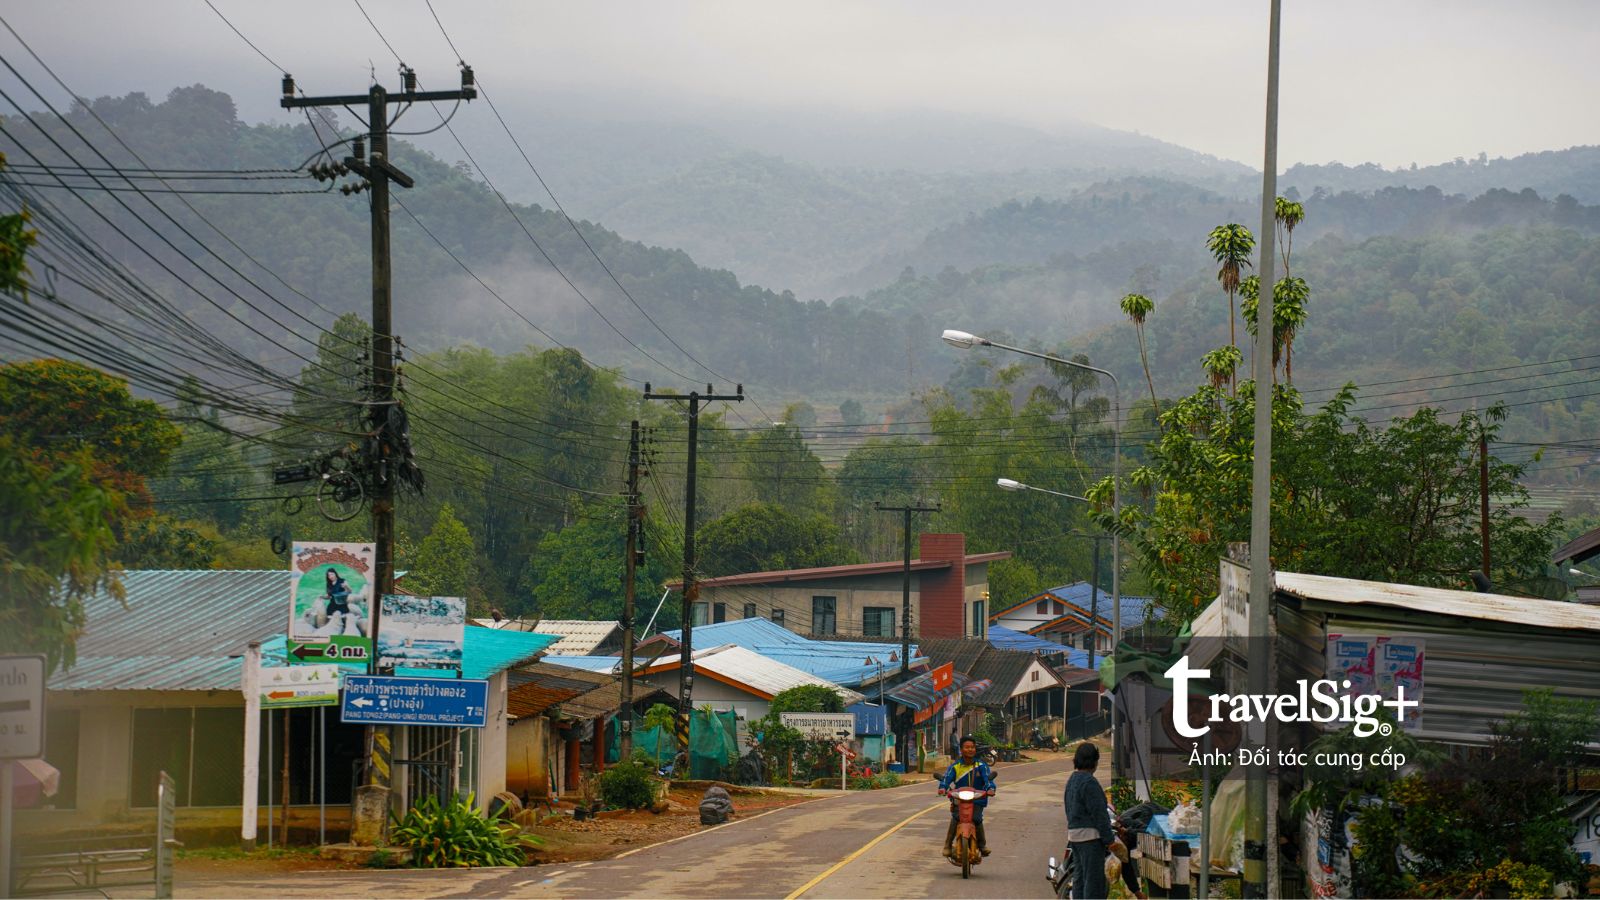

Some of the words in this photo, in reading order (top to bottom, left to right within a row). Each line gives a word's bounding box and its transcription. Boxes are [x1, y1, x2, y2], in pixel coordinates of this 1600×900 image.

[326, 644, 338, 657] 4
[341, 646, 368, 659] กม.
[345, 711, 362, 719] PANG
[418, 713, 437, 721] ROYAL
[438, 714, 465, 722] PROJECT
[466, 706, 474, 716] 7
